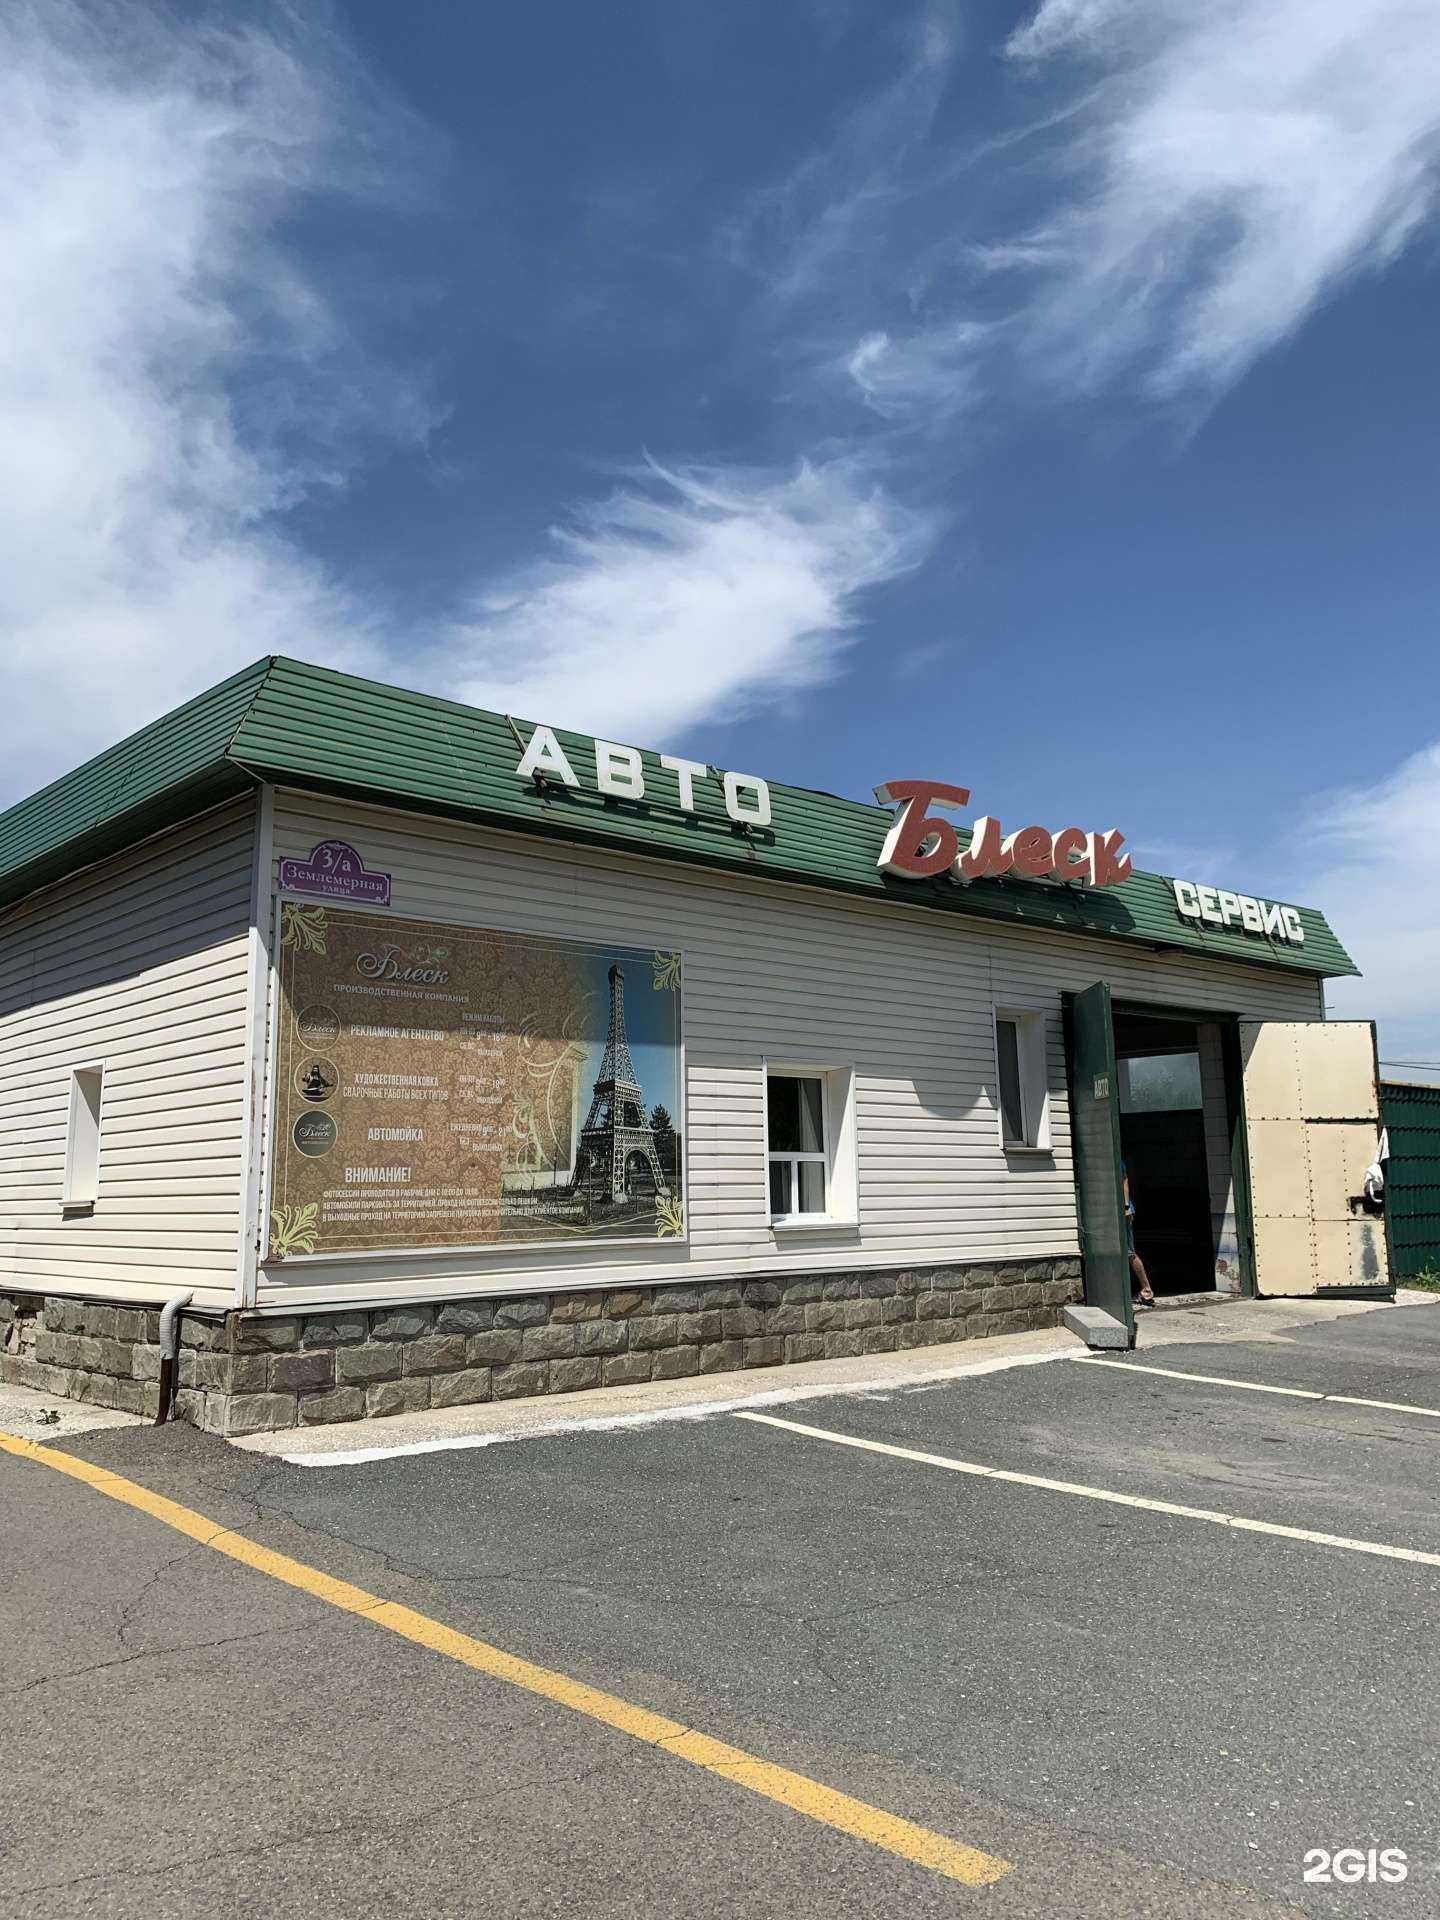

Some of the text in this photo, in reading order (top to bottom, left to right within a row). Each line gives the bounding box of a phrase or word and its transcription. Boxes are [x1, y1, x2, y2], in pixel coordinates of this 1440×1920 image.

[516, 725, 772, 827] АВТО
[873, 779, 1132, 889] Блеск
[287, 864, 385, 892] Землемерная
[1173, 879, 1305, 942] СЕРВИС
[356, 943, 449, 984] Блеск
[333, 984, 423, 999] ПРОИЗВОДСТВЕННАЯ
[350, 1024, 400, 1038] РЕКЛАМНОЕ
[400, 1028, 445, 1041] АГЕНТСТВО
[1094, 1078, 1110, 1098] АВТО
[367, 1127, 424, 1142] АВТОМОЙКА
[345, 1167, 412, 1183] ВНИМАНИЕ!
